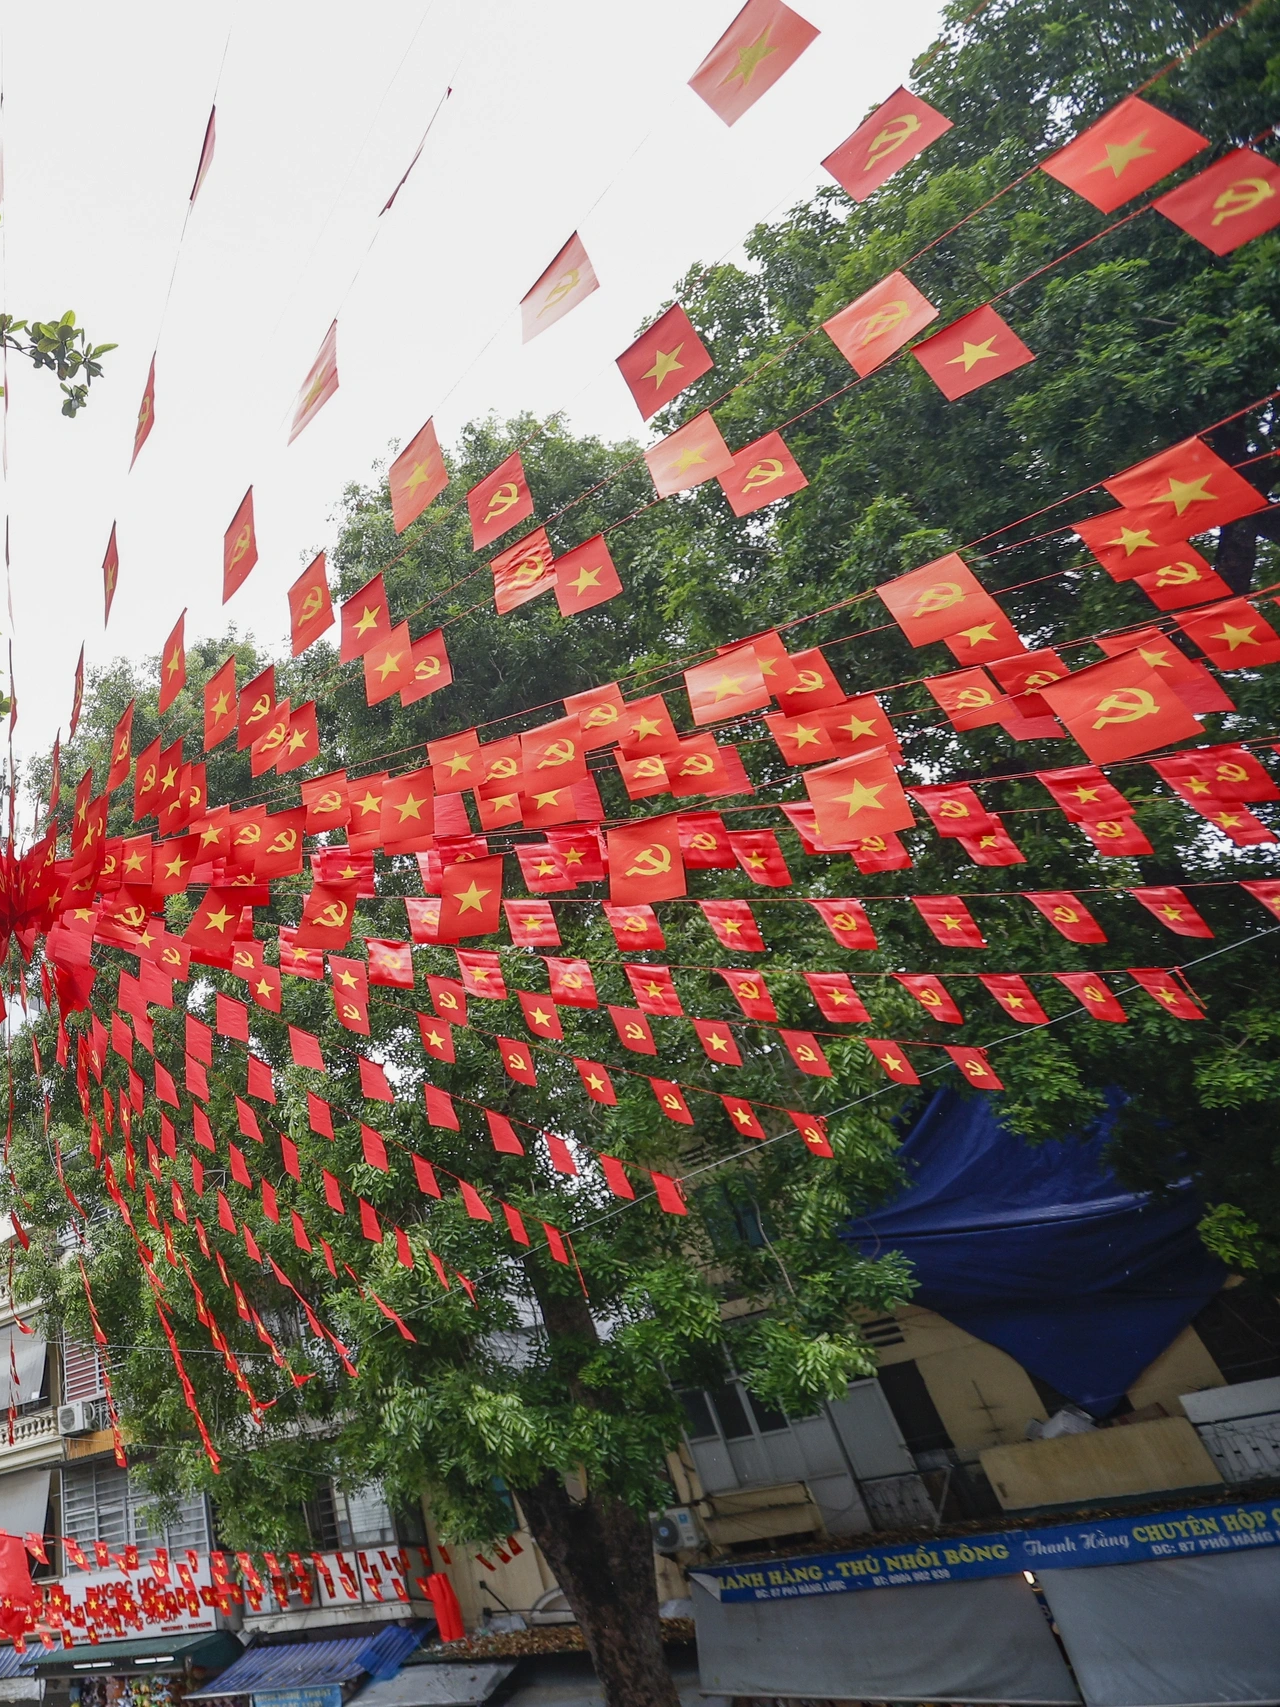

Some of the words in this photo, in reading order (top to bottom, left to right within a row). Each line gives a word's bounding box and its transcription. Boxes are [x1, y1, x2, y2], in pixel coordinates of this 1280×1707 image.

[1132, 1514, 1221, 1543] CHUYÊN
[1221, 1507, 1267, 1534] HỘP
[883, 1545, 942, 1573] NHỒI
[942, 1543, 1011, 1566] BÔNG
[1023, 1535, 1077, 1556] Thanh
[1178, 1540, 1196, 1554] 87
